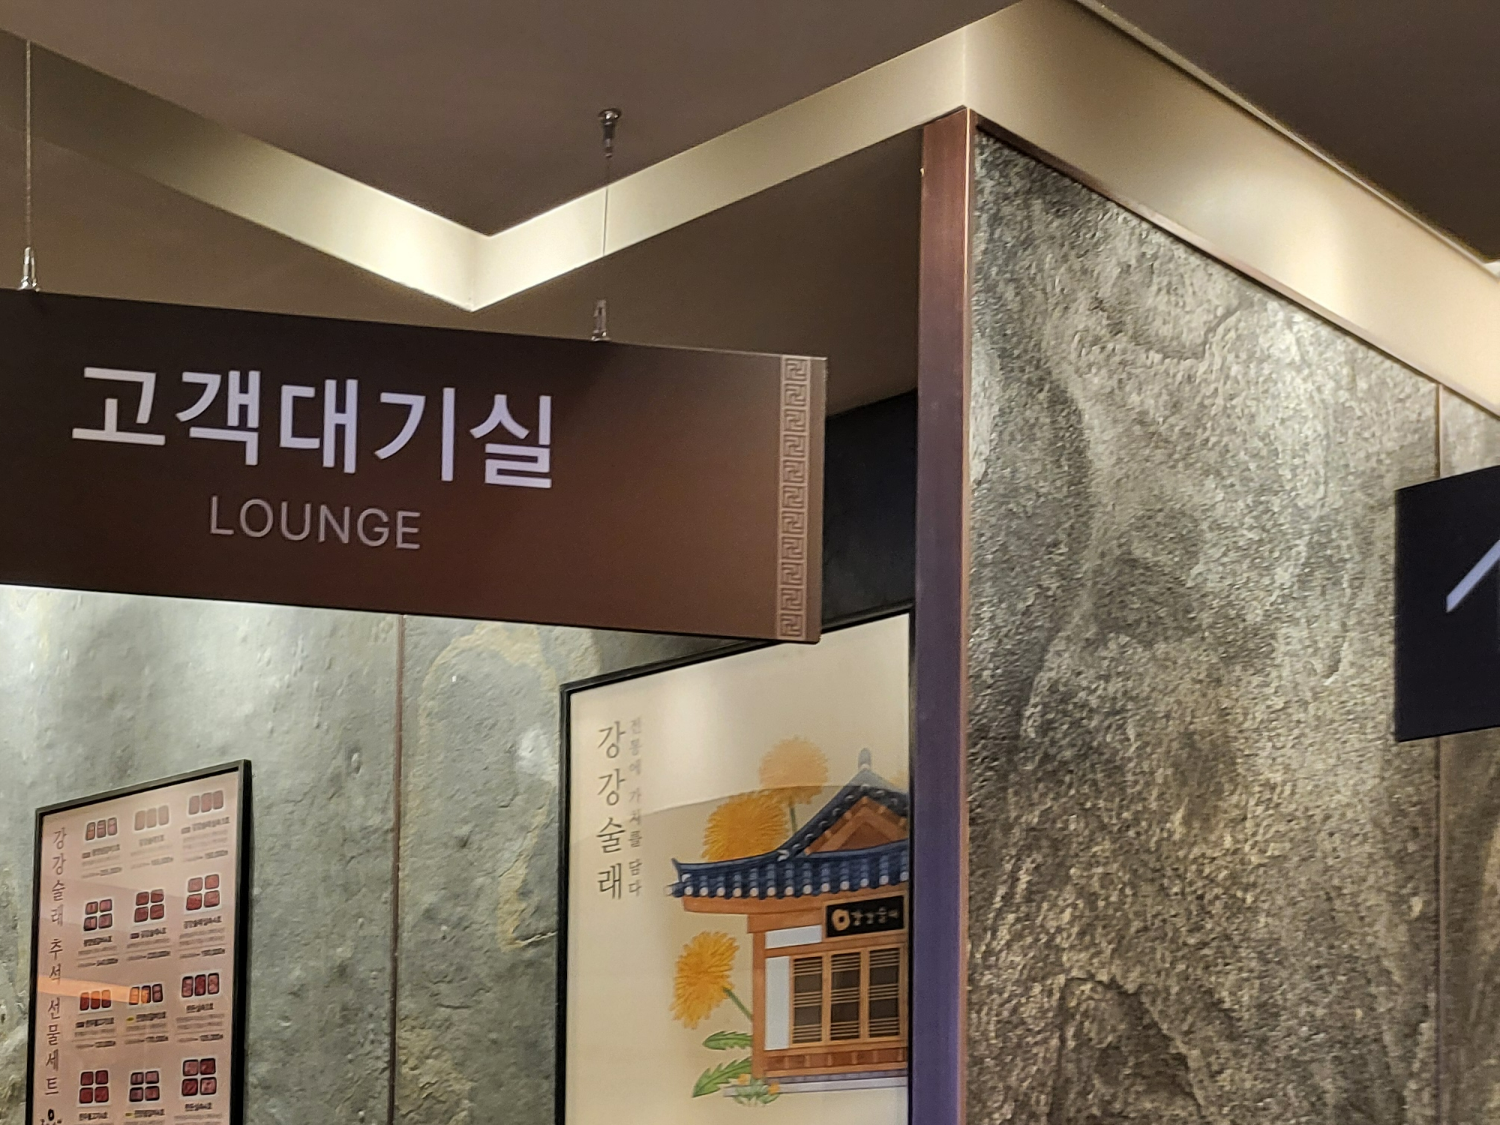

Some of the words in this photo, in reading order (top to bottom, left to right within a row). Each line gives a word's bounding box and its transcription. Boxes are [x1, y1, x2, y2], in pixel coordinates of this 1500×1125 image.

[71, 366, 552, 489] 고객대기실
[209, 495, 421, 550] LOUNGE
[596, 720, 626, 900] 강강술래
[628, 858, 643, 897] 담다
[48, 938, 63, 985] 추석
[44, 996, 61, 1096] 선물세트
